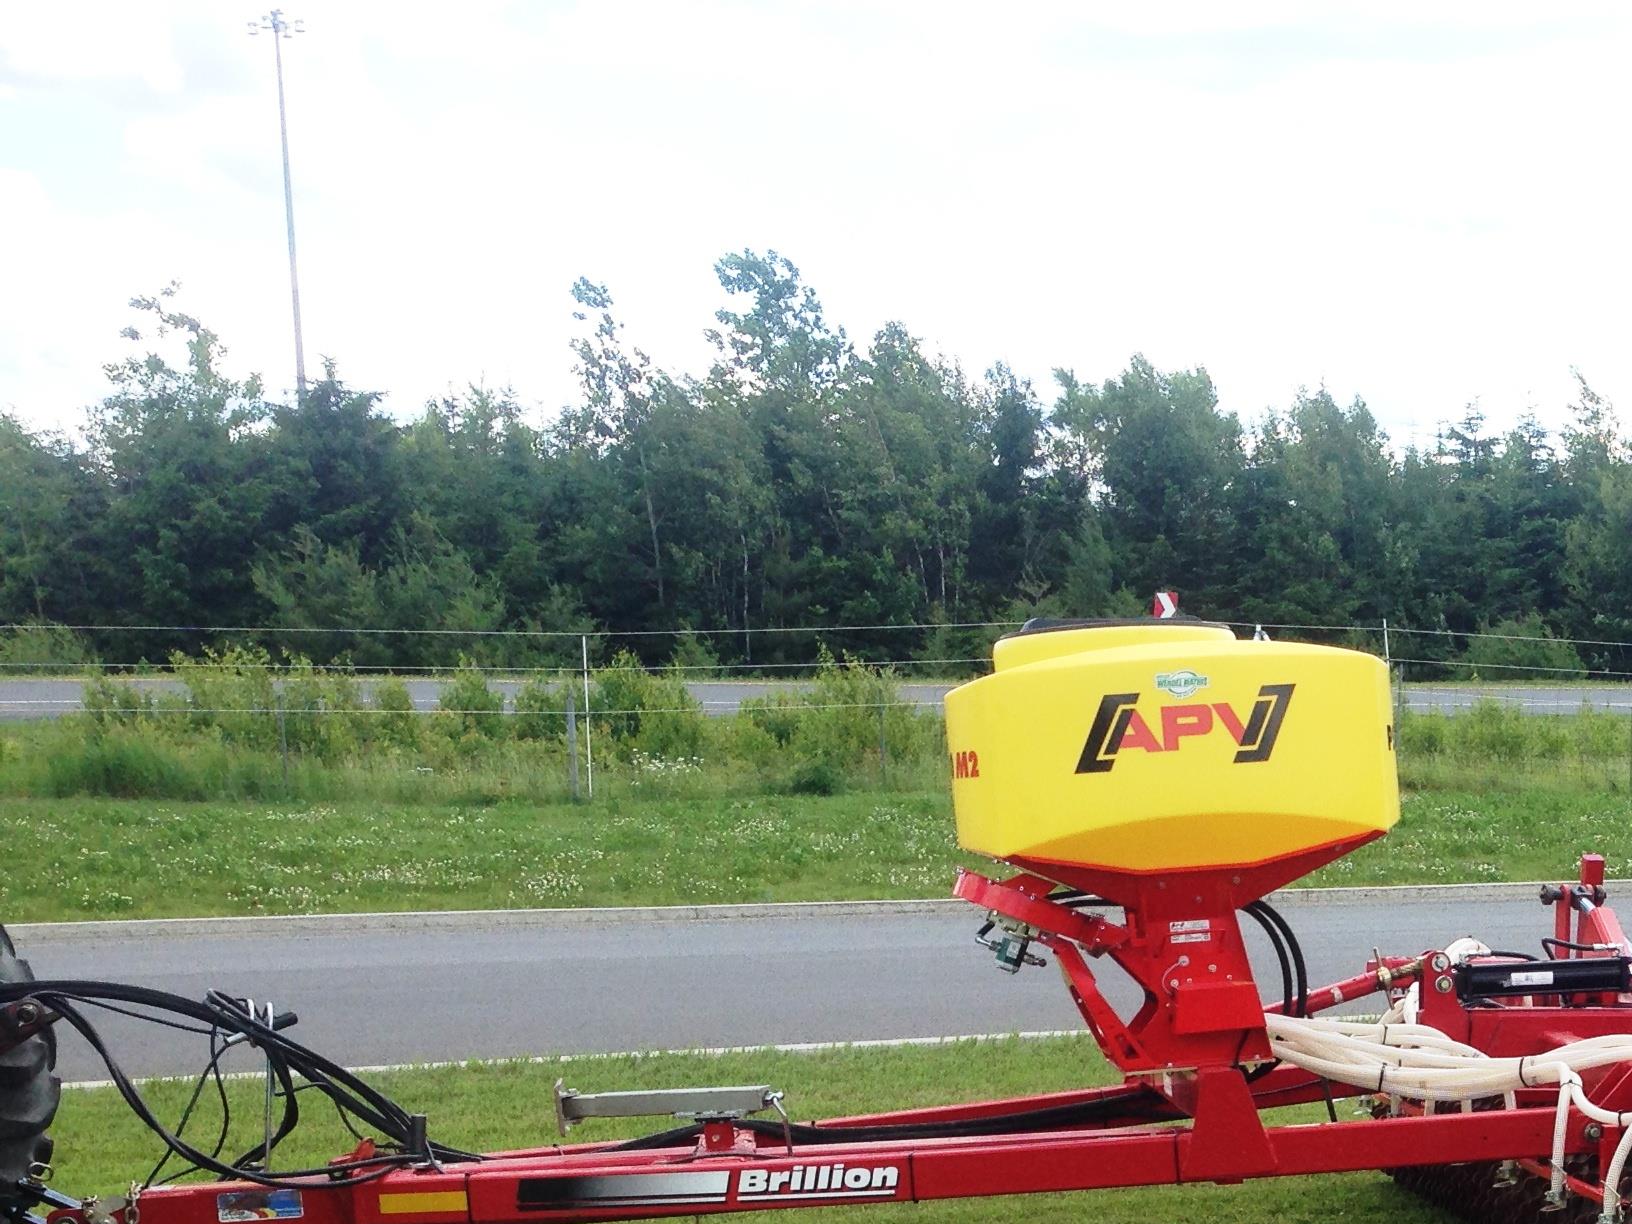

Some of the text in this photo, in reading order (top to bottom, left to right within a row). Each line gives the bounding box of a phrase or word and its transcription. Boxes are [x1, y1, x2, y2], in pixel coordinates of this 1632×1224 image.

[1103, 703, 1272, 756] APV
[956, 751, 980, 778] M2
[738, 1164, 899, 1193] Brillion
